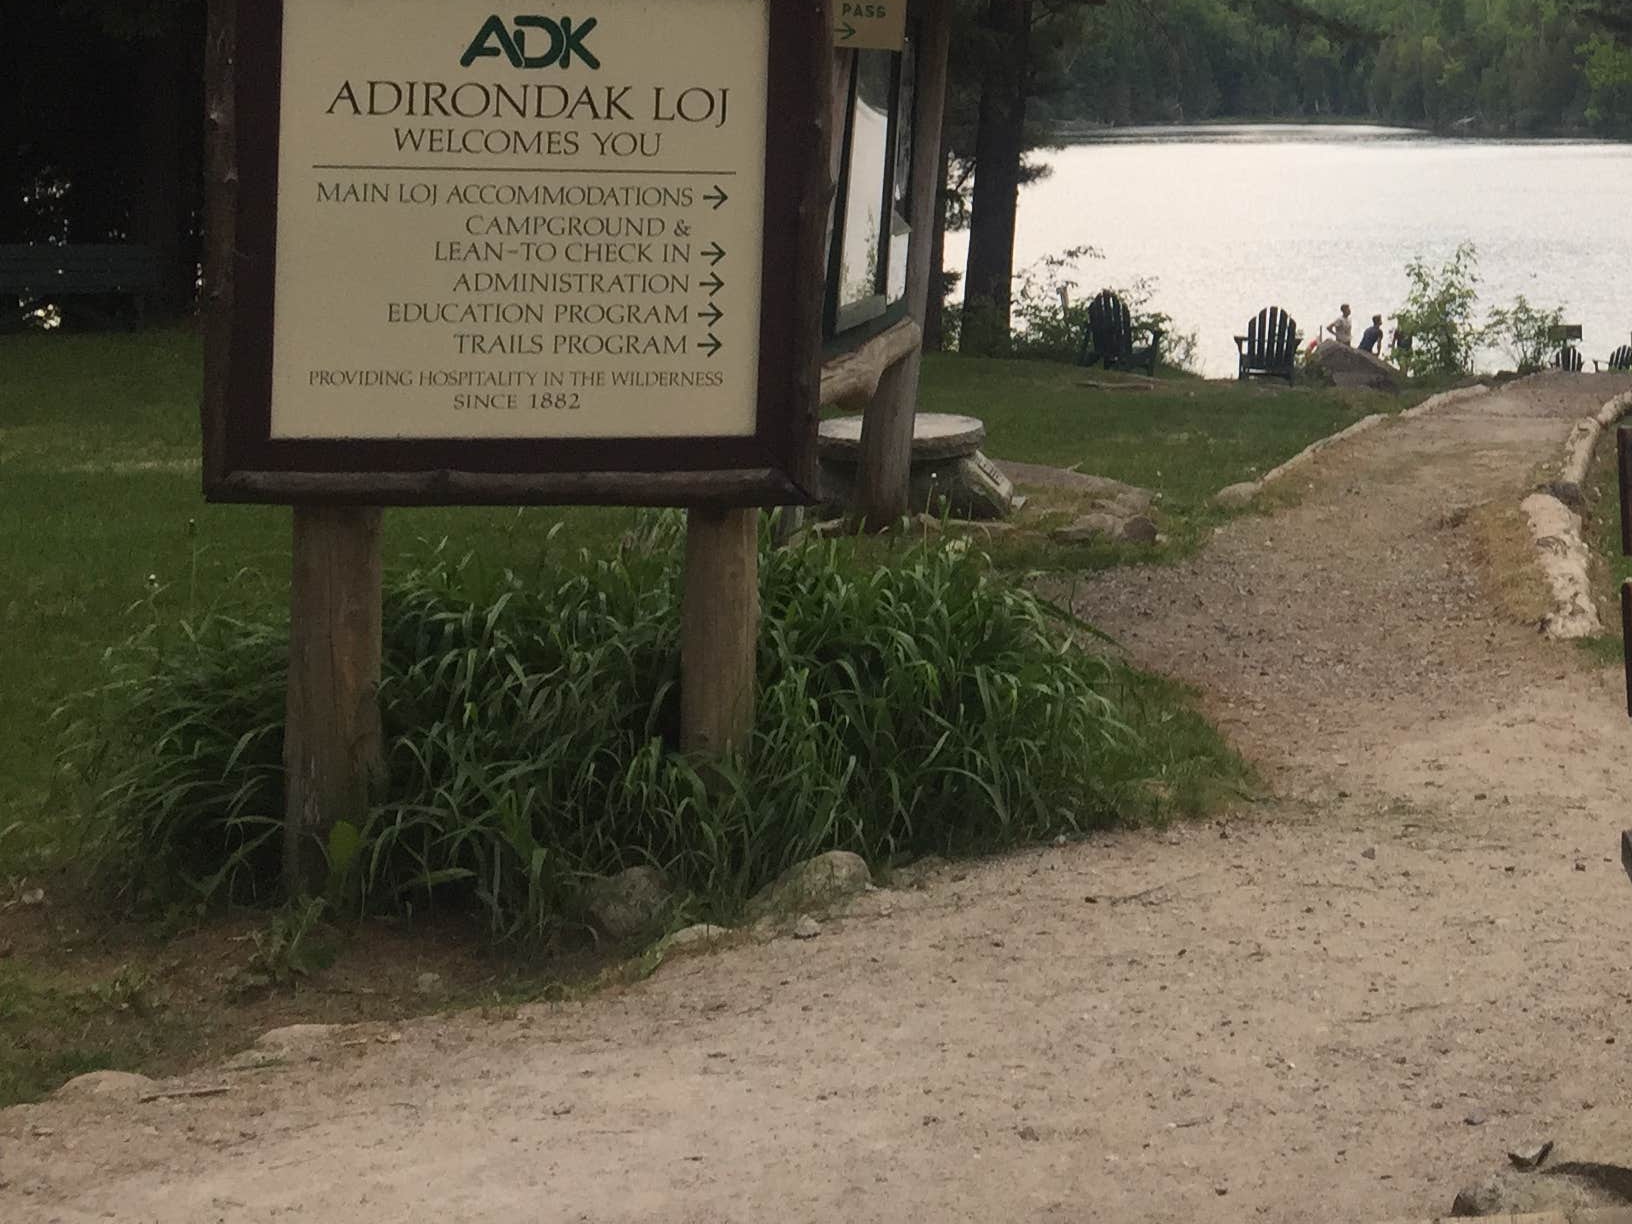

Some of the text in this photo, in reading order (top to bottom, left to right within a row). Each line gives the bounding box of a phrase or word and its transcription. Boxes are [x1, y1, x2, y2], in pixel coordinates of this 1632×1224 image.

[842, 3, 887, 18] PASS
[458, 13, 602, 72] ADK
[324, 79, 731, 129] ADIRONDAK LOJ
[391, 126, 664, 158] WELCOMES YOU
[316, 180, 694, 209] MAIN LOJ ACCOMMODATIONS
[464, 213, 693, 239] CAMPGROUND &
[434, 238, 692, 265] LEAN-TO CHECK IN
[451, 271, 690, 296] ADMINISTRATION
[387, 300, 689, 327] EDUCATION PROGRAM
[452, 331, 689, 358] TRAILS PROGRAM
[309, 367, 724, 391] PROVIDING HOSPITALITY IN THE WILDERNESS
[453, 391, 581, 411] SINCE 1882
